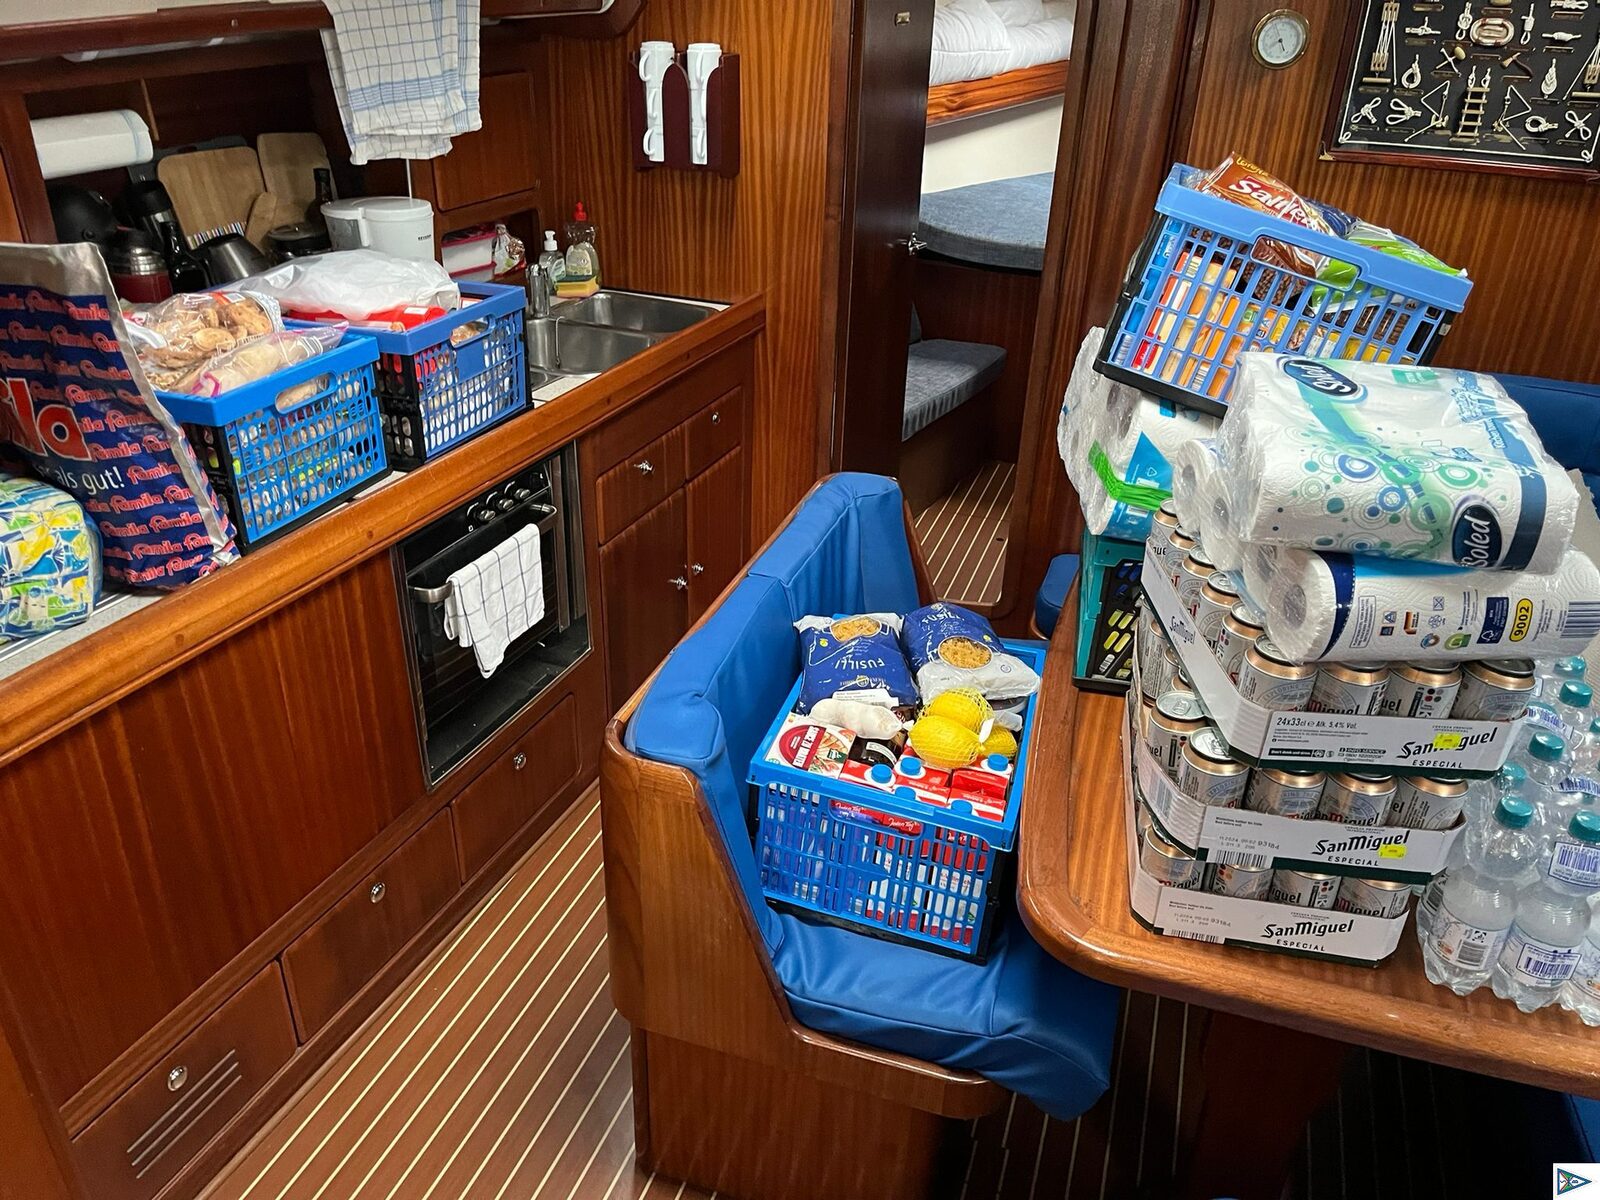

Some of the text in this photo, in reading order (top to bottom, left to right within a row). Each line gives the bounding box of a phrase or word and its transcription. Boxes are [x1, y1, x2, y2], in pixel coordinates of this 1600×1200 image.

[81, 466, 125, 495] gut!
[148, 511, 203, 534] famila
[1460, 514, 1491, 568] Soled
[1513, 603, 1531, 638] 9002
[834, 657, 886, 670] FUSILLI
[1396, 726, 1498, 760] Sanguel
[1412, 759, 1463, 769] ESPECIAL
[1311, 829, 1410, 856] SanMiguel
[1327, 855, 1379, 867] ESPECIAL
[1261, 919, 1355, 939] SanMiguel
[1276, 939, 1326, 952] ESPECIAL
